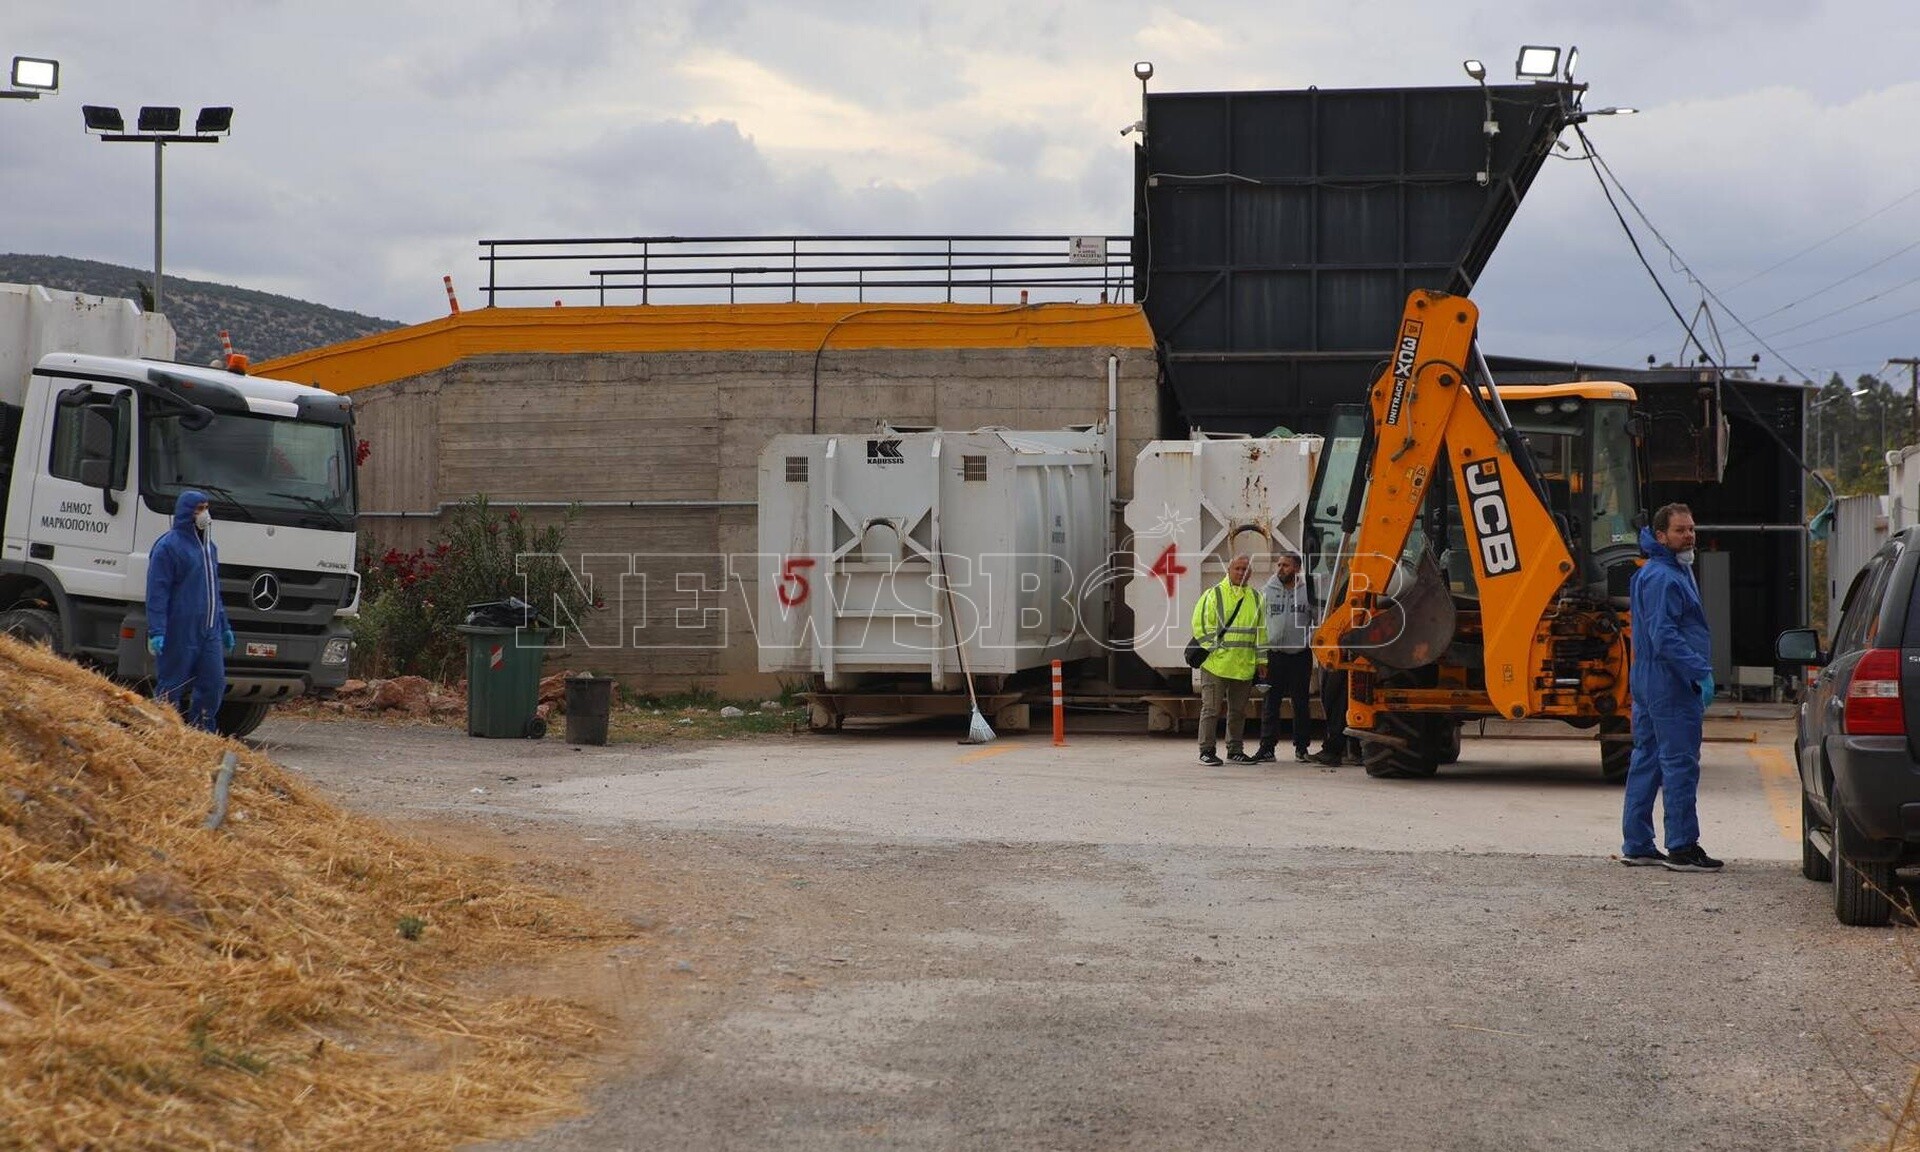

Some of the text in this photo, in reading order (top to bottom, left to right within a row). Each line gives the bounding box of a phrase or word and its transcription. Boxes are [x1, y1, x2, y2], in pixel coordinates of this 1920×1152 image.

[1388, 378, 1405, 424] UNITRACK
[41, 516, 110, 534] ΜΑΡΚΟΠΟΥΛΟΥ
[60, 501, 93, 515] ΔΗΜΟΣ
[1466, 464, 1517, 574] JCB
[779, 558, 817, 607] 5
[1149, 543, 1189, 599] 4
